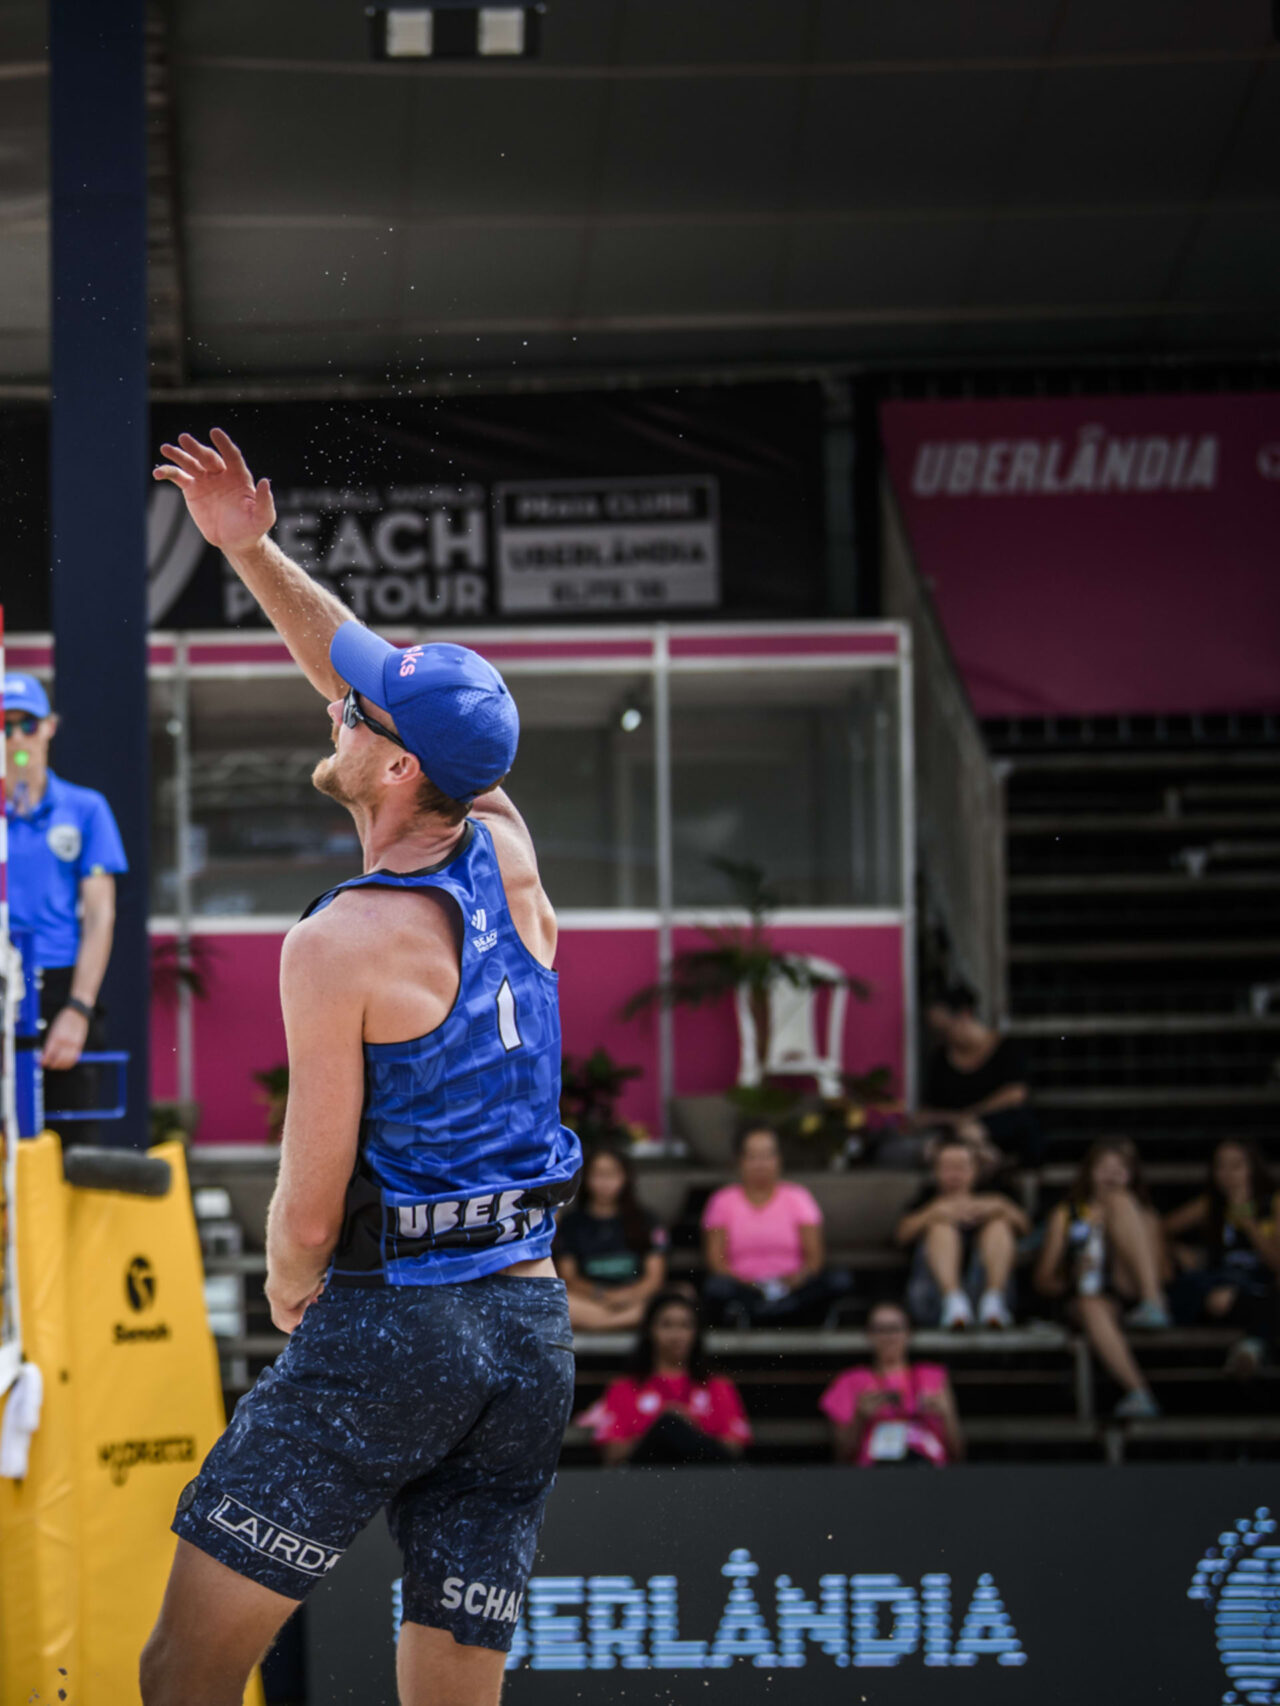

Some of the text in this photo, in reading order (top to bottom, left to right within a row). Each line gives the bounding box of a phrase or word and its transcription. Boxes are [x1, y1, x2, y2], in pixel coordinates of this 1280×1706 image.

[276, 511, 486, 572] EACH
[497, 974, 523, 1052] 1
[391, 1548, 1028, 1671] ERLÂNDIA
